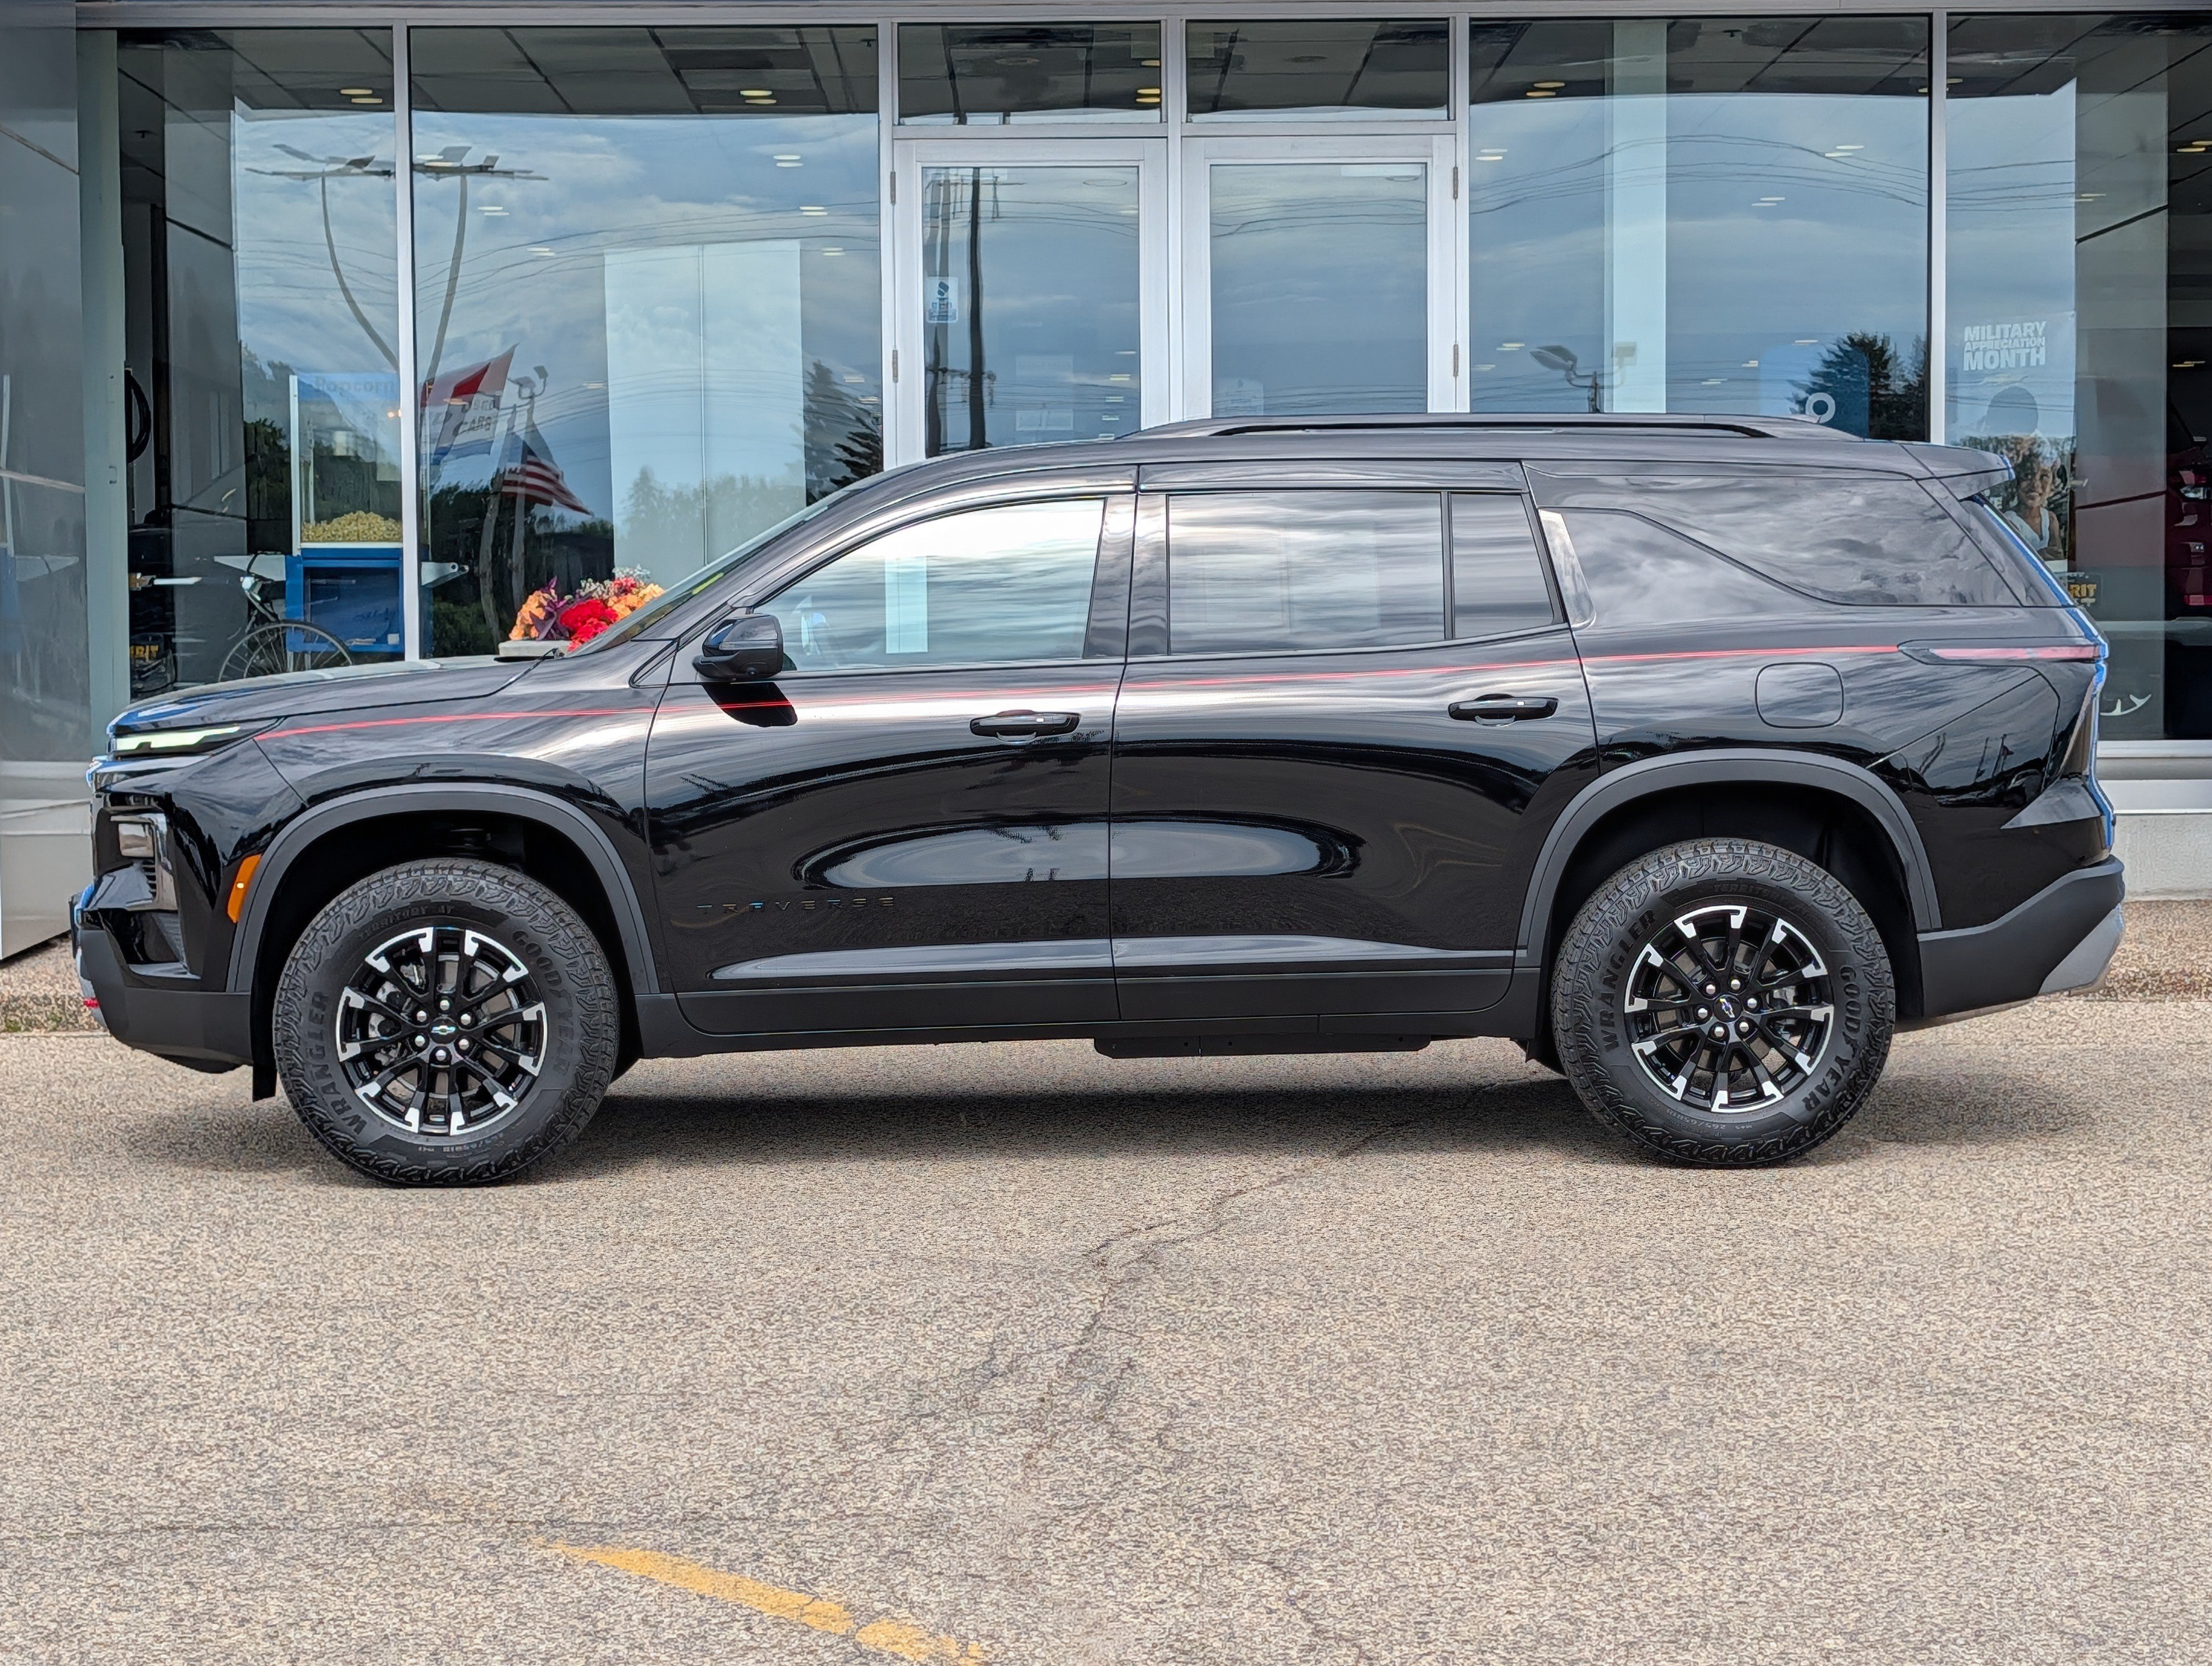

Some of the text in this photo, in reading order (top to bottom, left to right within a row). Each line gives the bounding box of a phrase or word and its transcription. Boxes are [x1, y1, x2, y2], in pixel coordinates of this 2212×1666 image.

[1964, 321, 2046, 342] MILITARY
[1964, 336, 2046, 353] APPRECIATION
[1963, 347, 2046, 371] MONTH
[315, 375, 395, 397] Popcorn
[696, 897, 895, 914] TRAVERSE
[1599, 909, 1656, 1052] WRANGLER
[306, 991, 368, 1135] WRANGLER
[1666, 1108, 1726, 1130] 265/65R18
